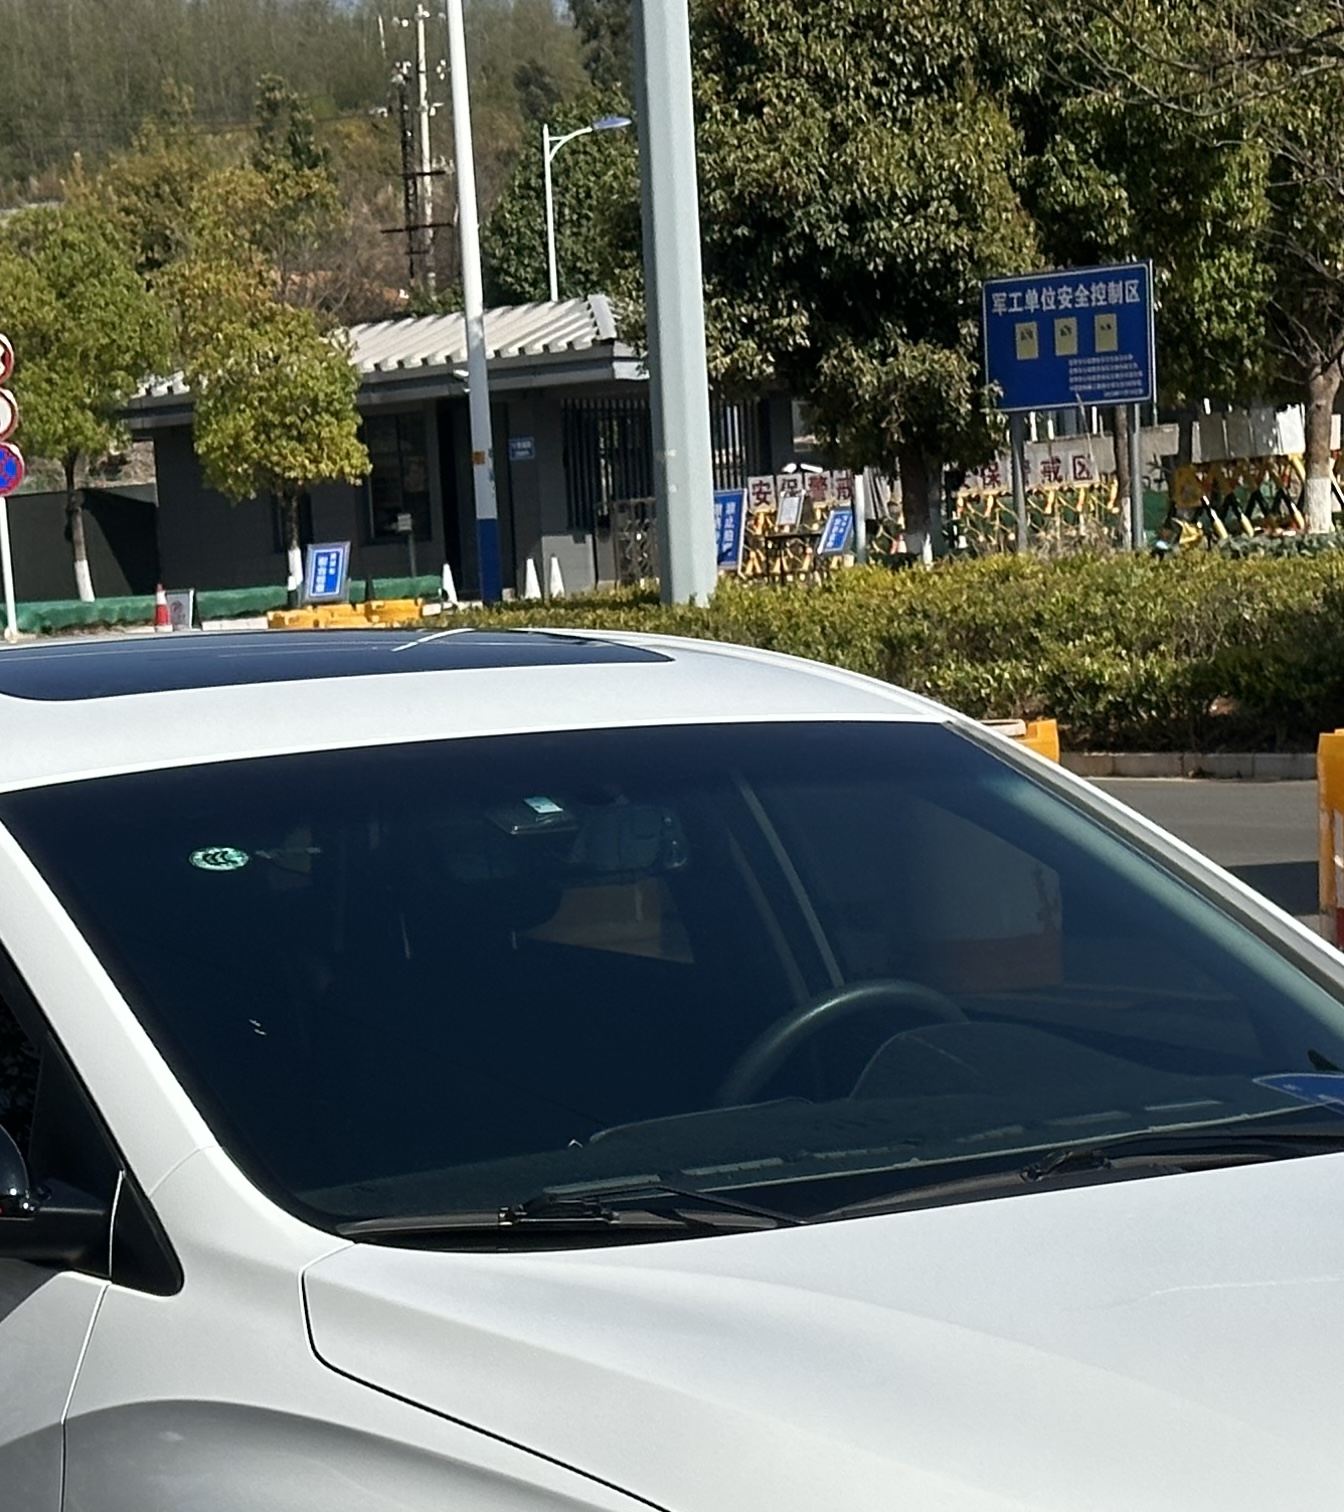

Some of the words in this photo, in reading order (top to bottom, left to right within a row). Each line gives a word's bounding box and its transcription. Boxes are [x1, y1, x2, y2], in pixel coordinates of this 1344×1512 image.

[990, 279, 1141, 317] 军工单位安全控制区
